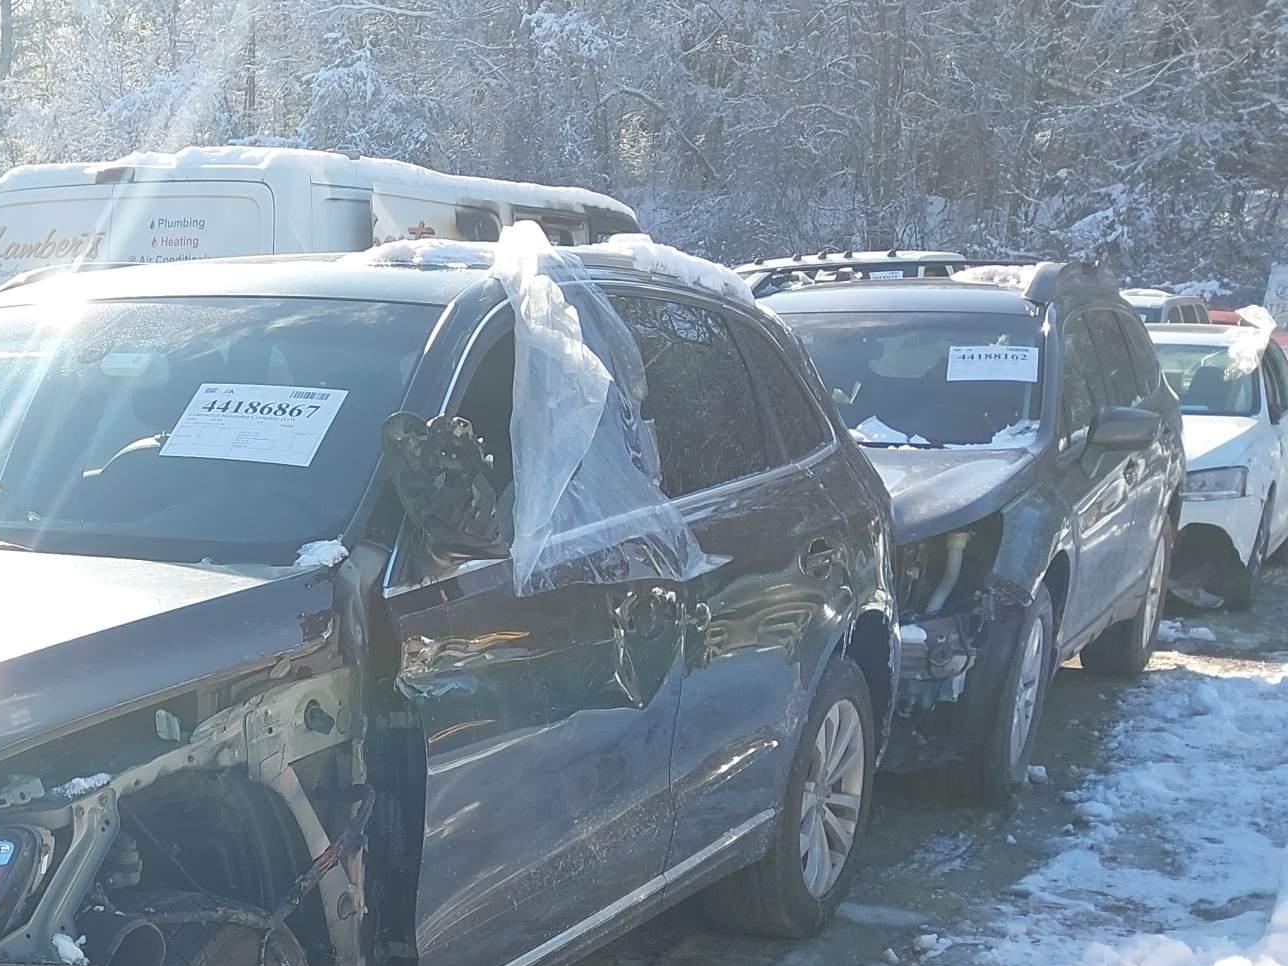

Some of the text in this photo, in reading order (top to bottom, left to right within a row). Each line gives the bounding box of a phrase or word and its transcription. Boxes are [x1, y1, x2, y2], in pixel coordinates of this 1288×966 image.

[158, 217, 205, 230] Plumbing
[161, 236, 199, 249] Heating
[202, 399, 321, 419] 44186867
